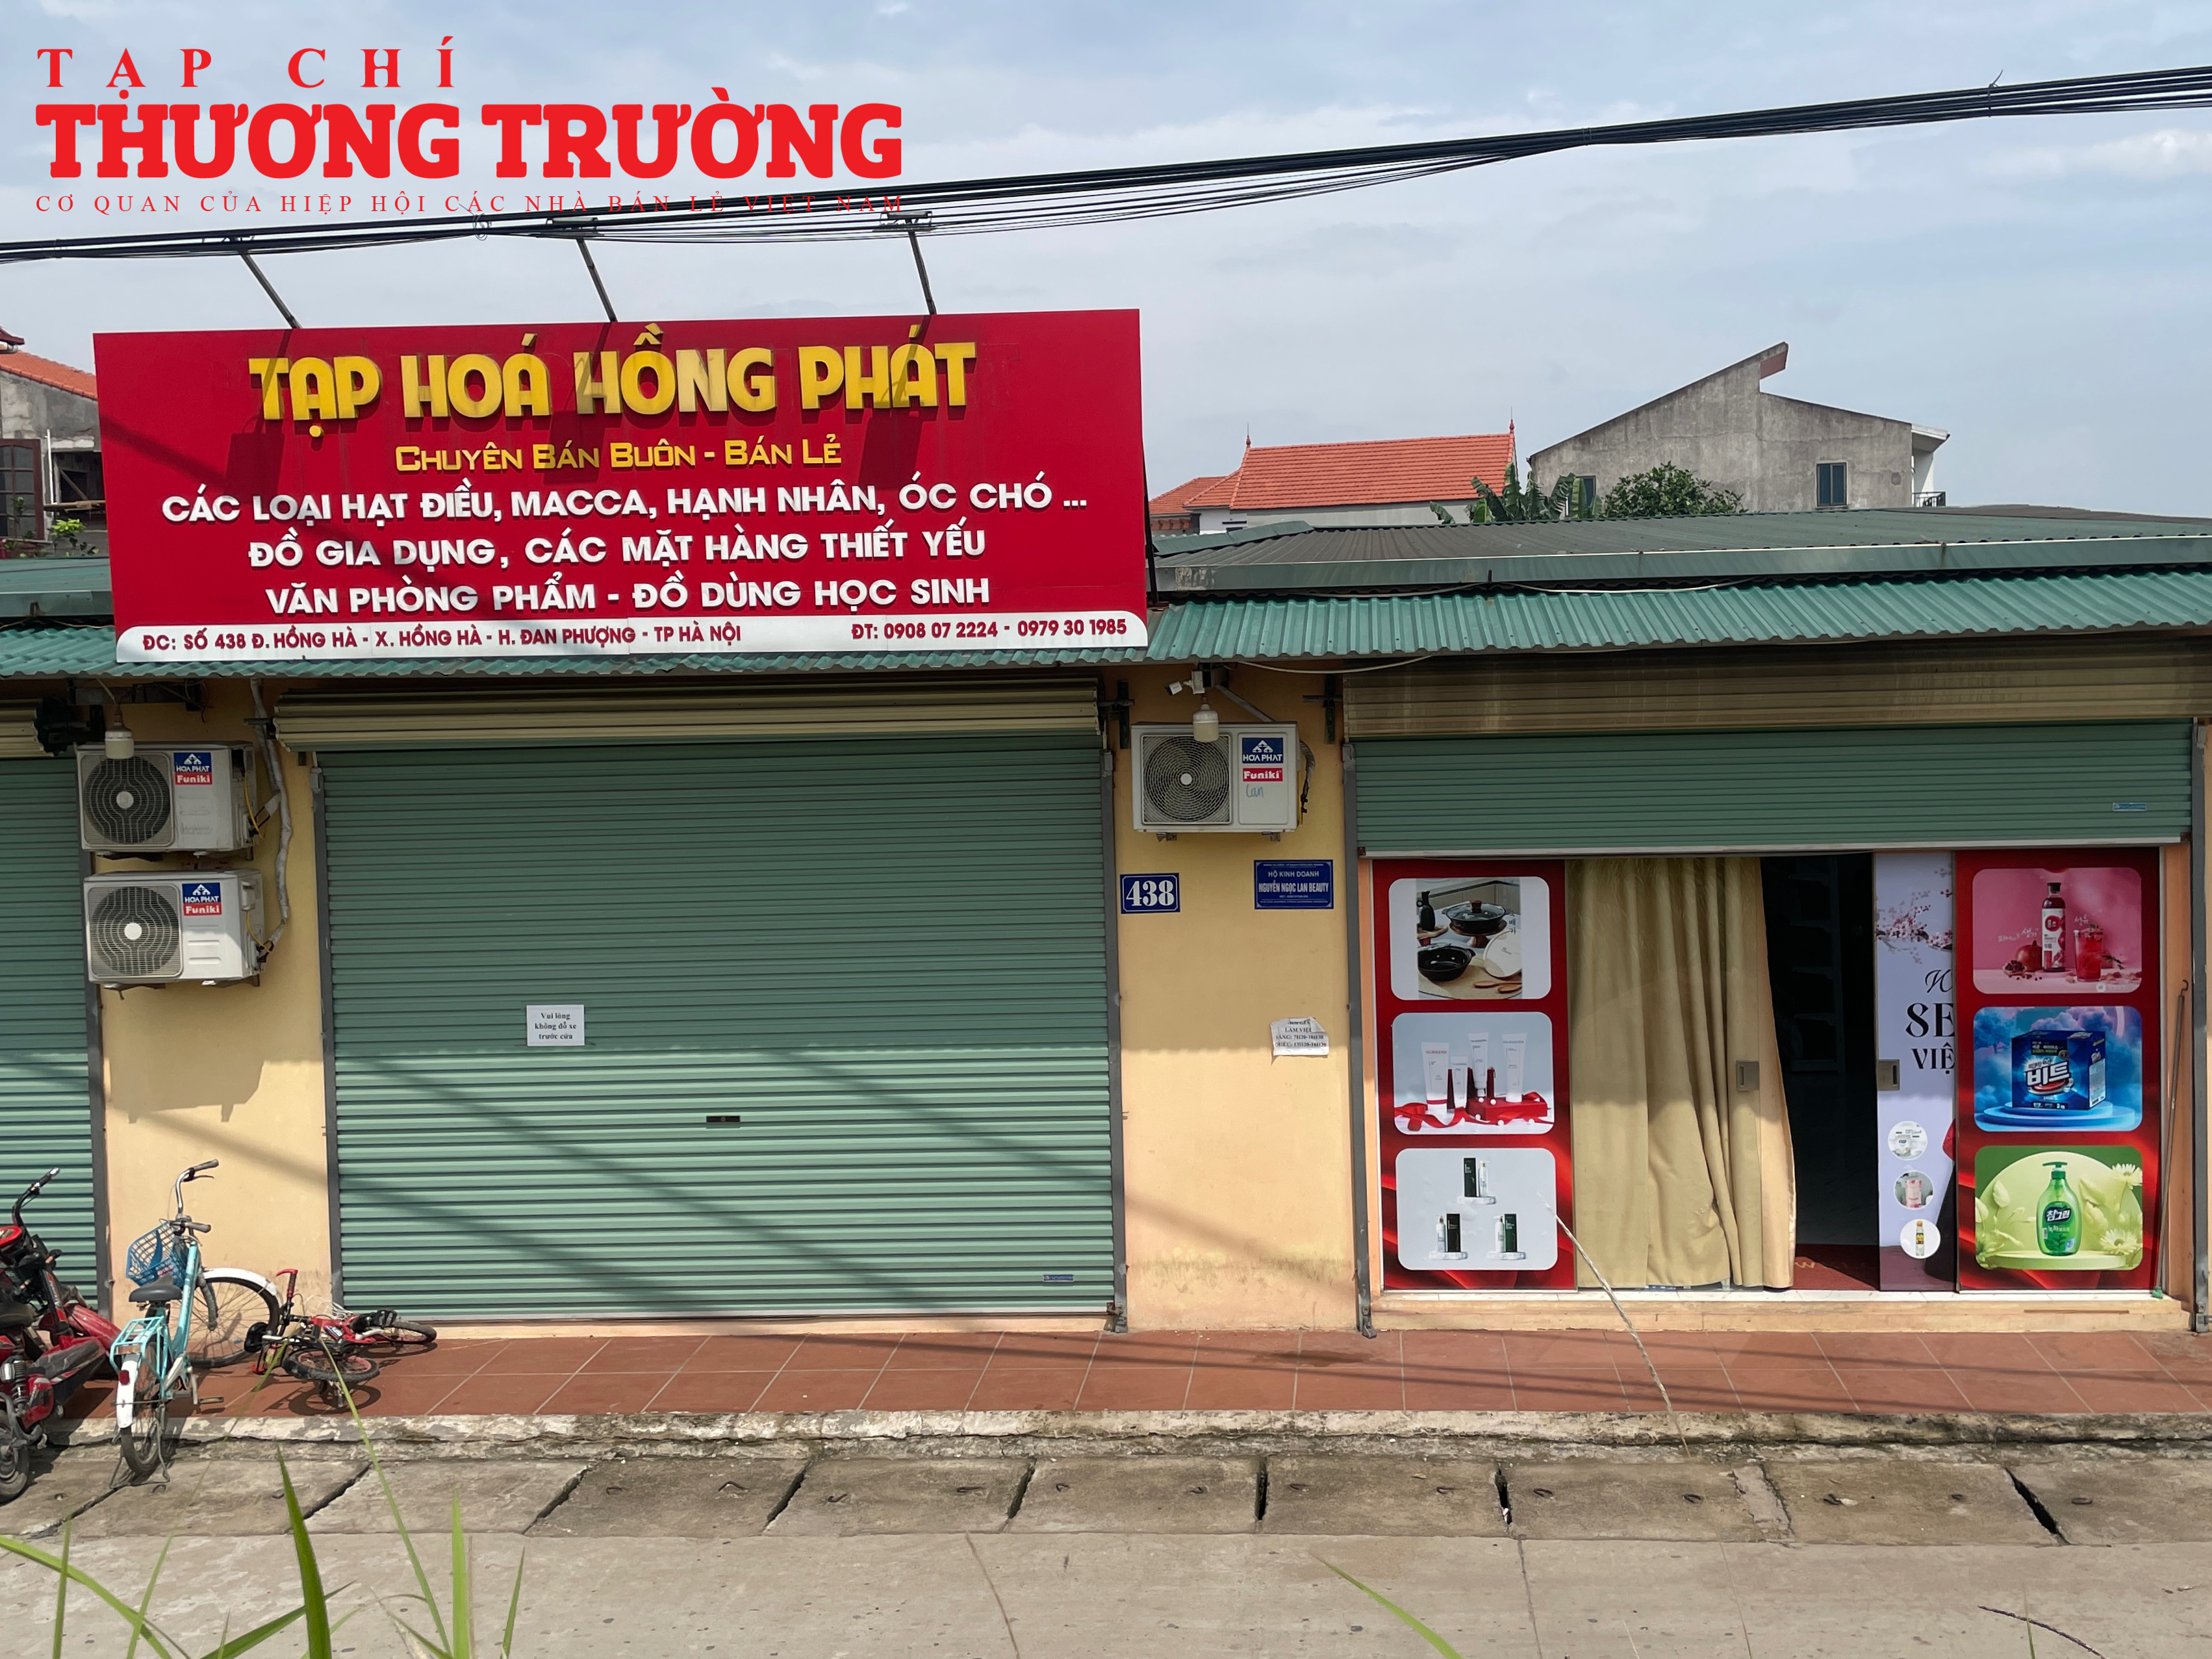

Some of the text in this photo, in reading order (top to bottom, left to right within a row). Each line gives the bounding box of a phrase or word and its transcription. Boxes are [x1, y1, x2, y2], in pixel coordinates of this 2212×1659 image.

[249, 323, 976, 437] TẠP HOÁ HỒNG PHÁT
[162, 483, 240, 522] CÁC
[253, 494, 331, 526] LOẠI
[342, 493, 408, 526] HẠT
[420, 477, 502, 522] ĐIỀU,
[511, 490, 657, 519] MACCA,
[667, 487, 766, 520] HẠNH
[778, 479, 885, 515] NHÂN,
[899, 471, 956, 509] ÓC
[970, 471, 1052, 509] CHÓ
[248, 527, 303, 566] ĐỒ
[316, 540, 381, 565] GIA
[525, 527, 606, 563] CÁC
[622, 529, 693, 566] MẶT
[706, 524, 808, 560] HÀNG
[820, 518, 908, 558] THIẾT
[922, 516, 985, 556] YẾU
[266, 583, 338, 613] VĂN
[350, 575, 478, 613] PHÒNG
[492, 572, 596, 610] PHẨM
[632, 570, 688, 607] ĐỒ
[701, 571, 801, 607] DÙNG
[815, 579, 896, 611] HỌC
[911, 578, 989, 604] SINH
[143, 635, 175, 650] ĐC:
[183, 627, 209, 649] SỐ
[215, 634, 246, 648] 438
[273, 625, 325, 648] HỒNG
[333, 627, 357, 646] HÀ
[400, 624, 451, 646] HỒNG
[457, 624, 481, 644] HÀ
[520, 629, 557, 644] ĐAN
[563, 627, 635, 647] PHƯỢNG
[655, 627, 674, 641] TP
[680, 621, 704, 641] HÀ
[710, 622, 740, 644] NỘI
[852, 624, 878, 639] ĐT:
[884, 623, 926, 639] 0908
[932, 623, 950, 638] 07
[956, 622, 998, 637] 2224
[1018, 620, 1058, 636] 0979
[1064, 620, 1084, 635] 30
[1089, 619, 1126, 634] 1985
[177, 774, 210, 783] Funiki
[1243, 770, 1280, 779] Funiki
[1126, 880, 1175, 906] 438
[1297, 883, 1308, 893] LAN
[1309, 883, 1328, 893] BEAUTY
[185, 905, 220, 914] Funiki
[2026, 1061, 2070, 1086] 비트
[2046, 1209, 2071, 1222] 참그린
